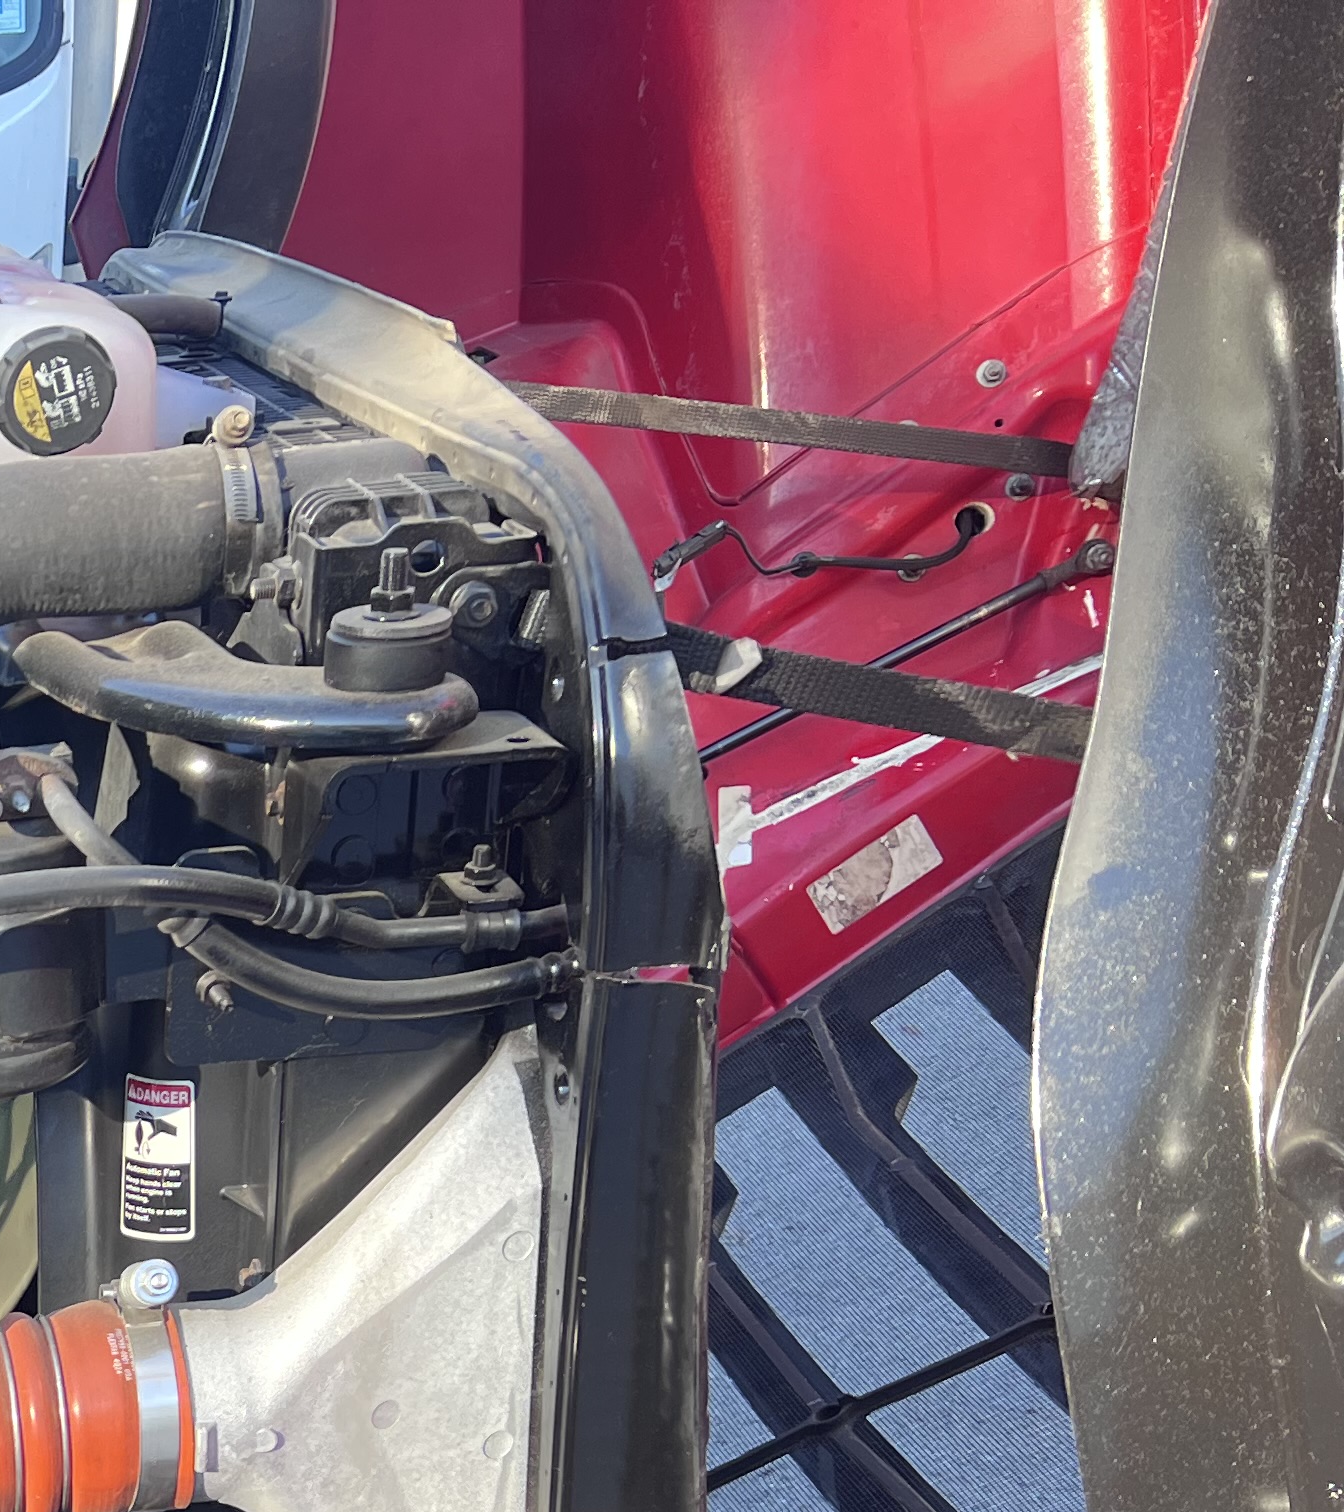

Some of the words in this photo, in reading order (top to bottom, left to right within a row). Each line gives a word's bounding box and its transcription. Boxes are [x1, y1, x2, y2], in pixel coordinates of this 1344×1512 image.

[136, 1086, 189, 1105] DANGER
[125, 1162, 162, 1177] Automatic
[163, 1168, 181, 1177] Fan
[125, 1174, 140, 1185] Keep
[140, 1178, 162, 1188] hands
[162, 1180, 182, 1188] clear
[125, 1184, 140, 1193] when
[140, 1187, 164, 1197] engine
[165, 1188, 173, 1197] is
[124, 1201, 135, 1211] Fan
[135, 1205, 156, 1215] starts
[156, 1208, 165, 1216] or
[165, 1208, 188, 1218] stops
[124, 1210, 132, 1220] by
